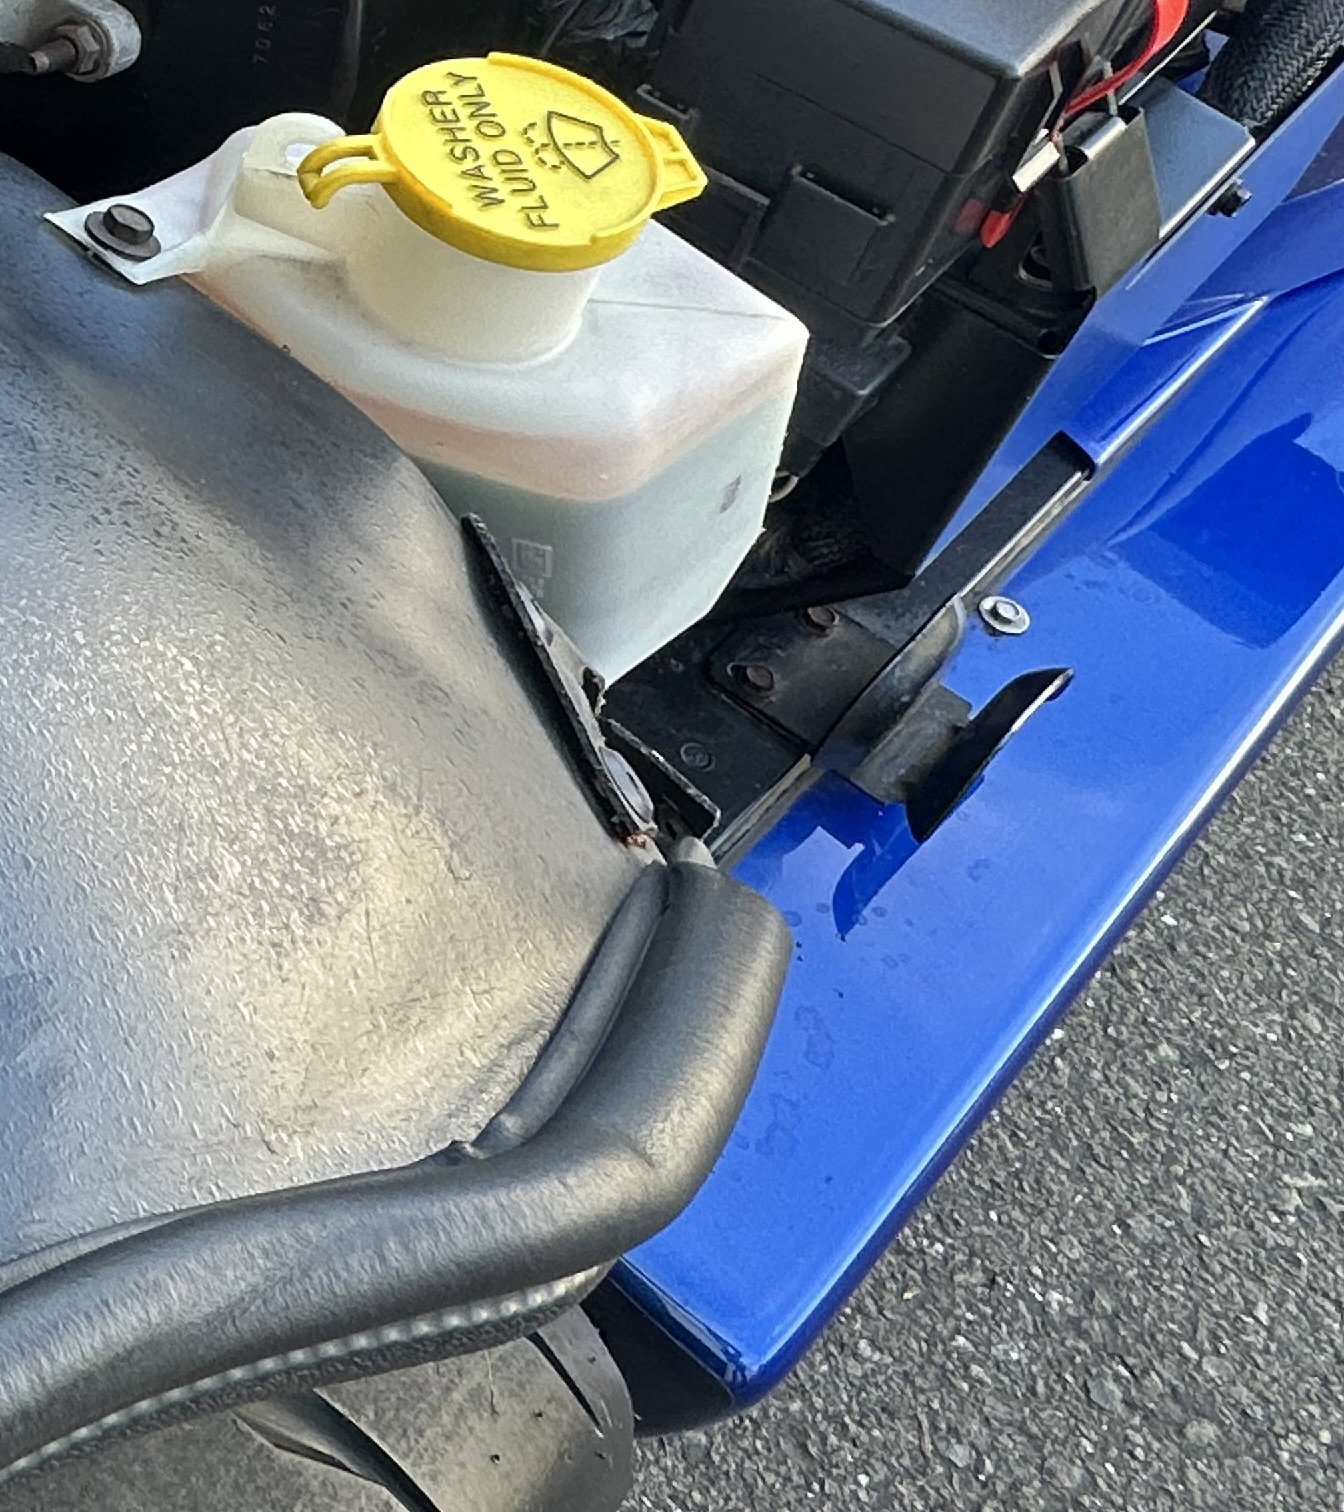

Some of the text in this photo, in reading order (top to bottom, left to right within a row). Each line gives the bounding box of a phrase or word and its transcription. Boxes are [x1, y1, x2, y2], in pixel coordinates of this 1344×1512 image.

[422, 90, 505, 209] WASHER
[447, 71, 560, 230] FLUID ONLY
